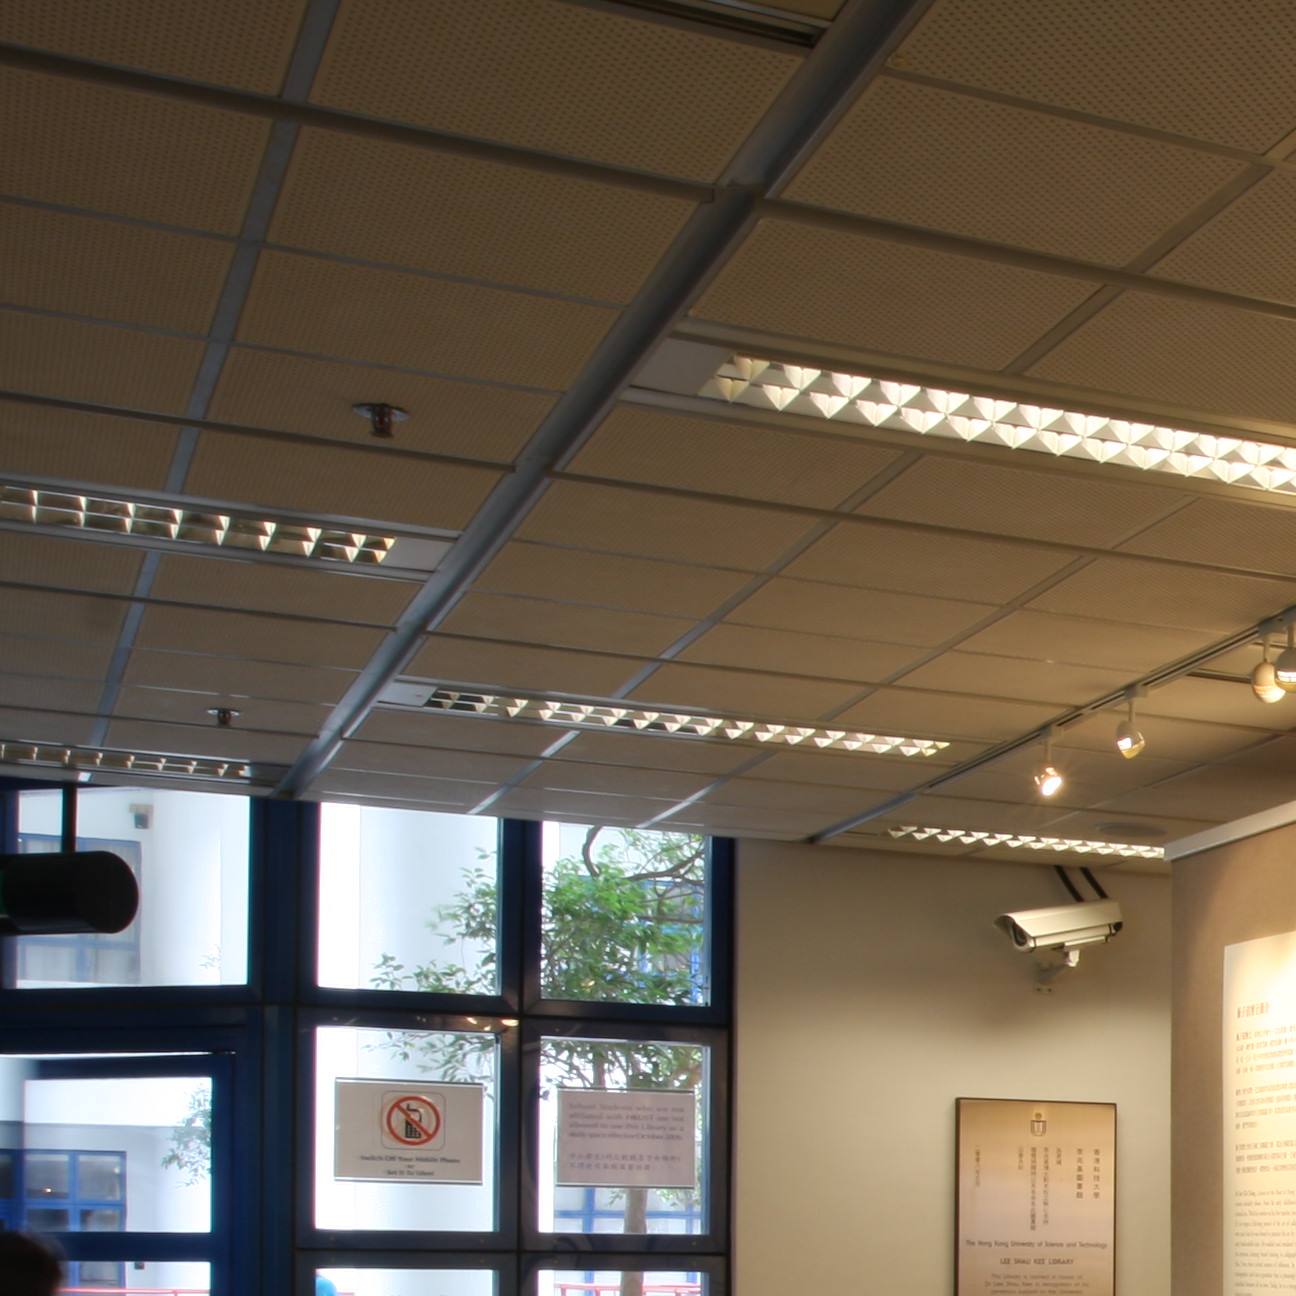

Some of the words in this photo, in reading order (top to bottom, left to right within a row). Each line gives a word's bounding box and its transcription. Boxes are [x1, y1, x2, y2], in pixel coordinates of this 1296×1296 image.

[1076, 1148, 1084, 1199] 李兆基圖書館
[1093, 1148, 1101, 1199] 香港科技大學
[978, 1240, 992, 1248] Hong
